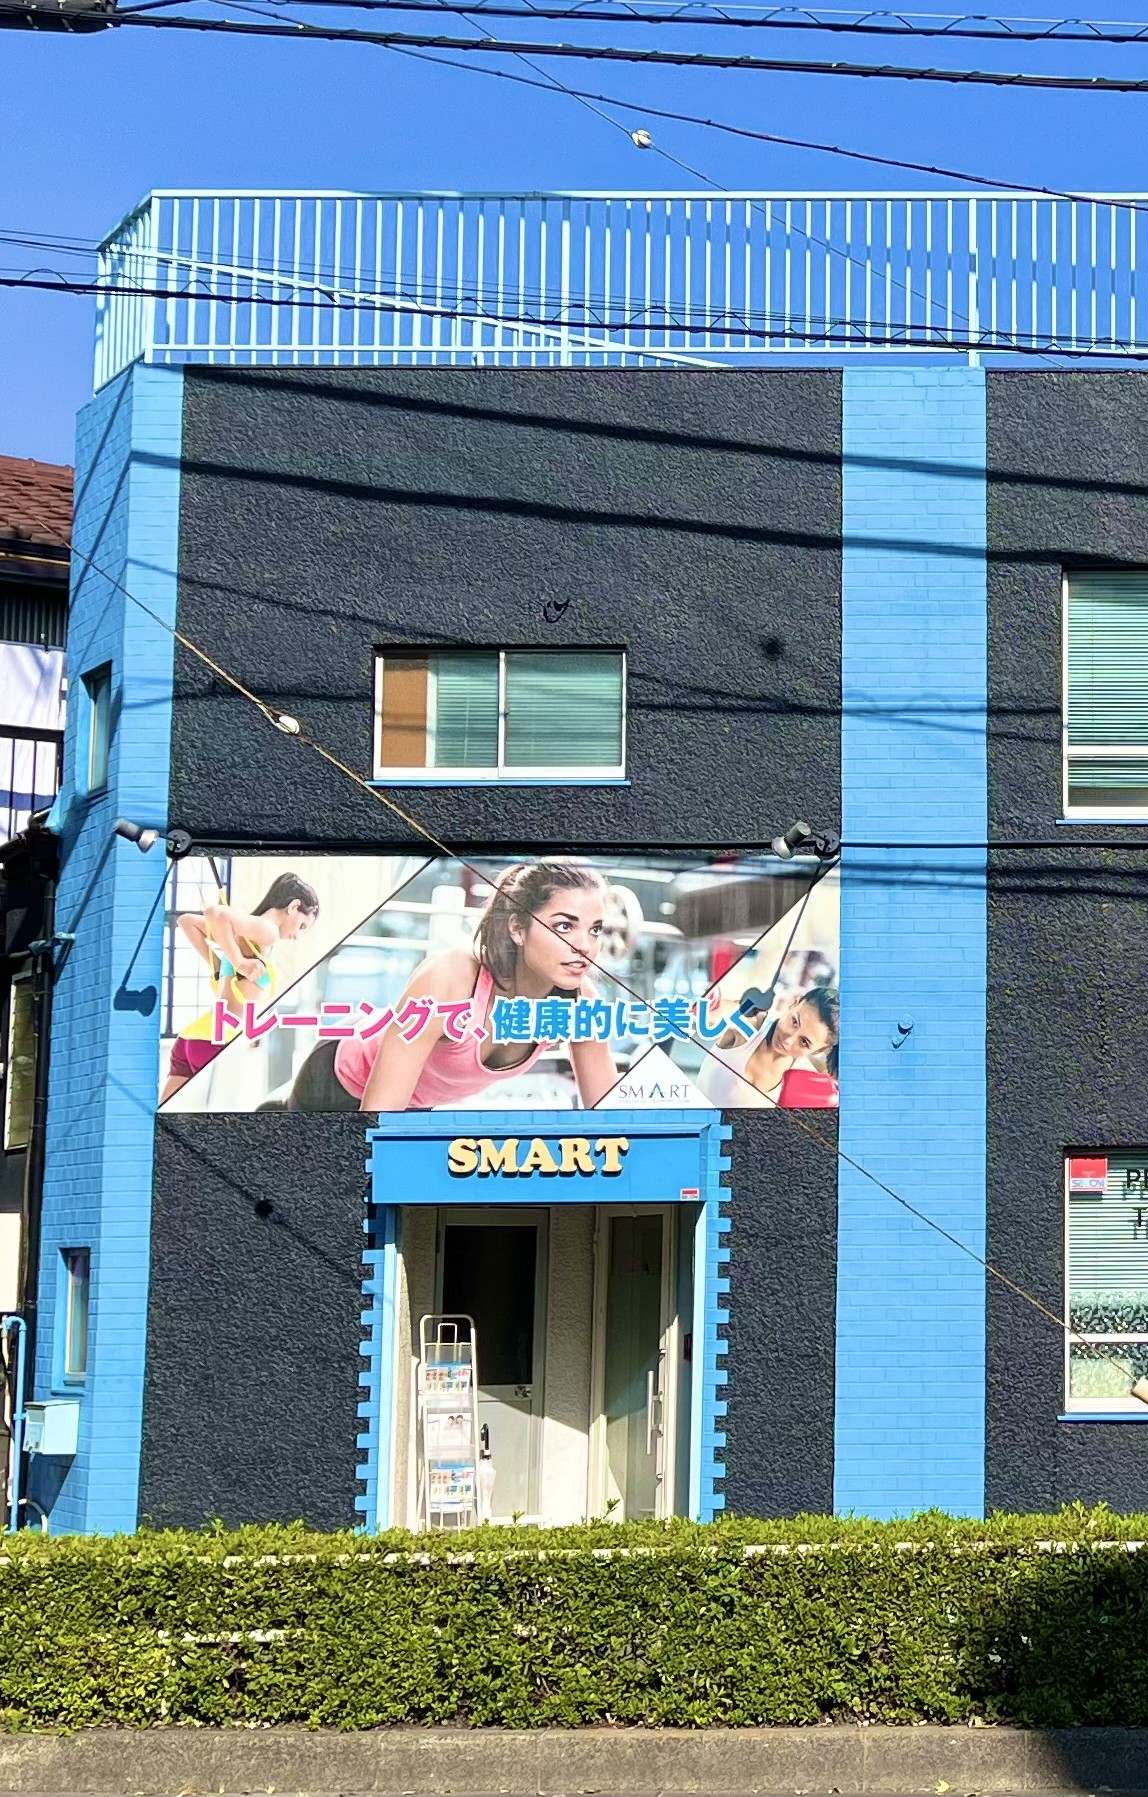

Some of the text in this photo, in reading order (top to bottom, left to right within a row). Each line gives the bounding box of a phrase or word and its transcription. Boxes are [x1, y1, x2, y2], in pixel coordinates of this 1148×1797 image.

[211, 998, 755, 1044] トレーニングで、健康的に美しく
[619, 1081, 690, 1098] SMART
[448, 1137, 630, 1177] SMART
